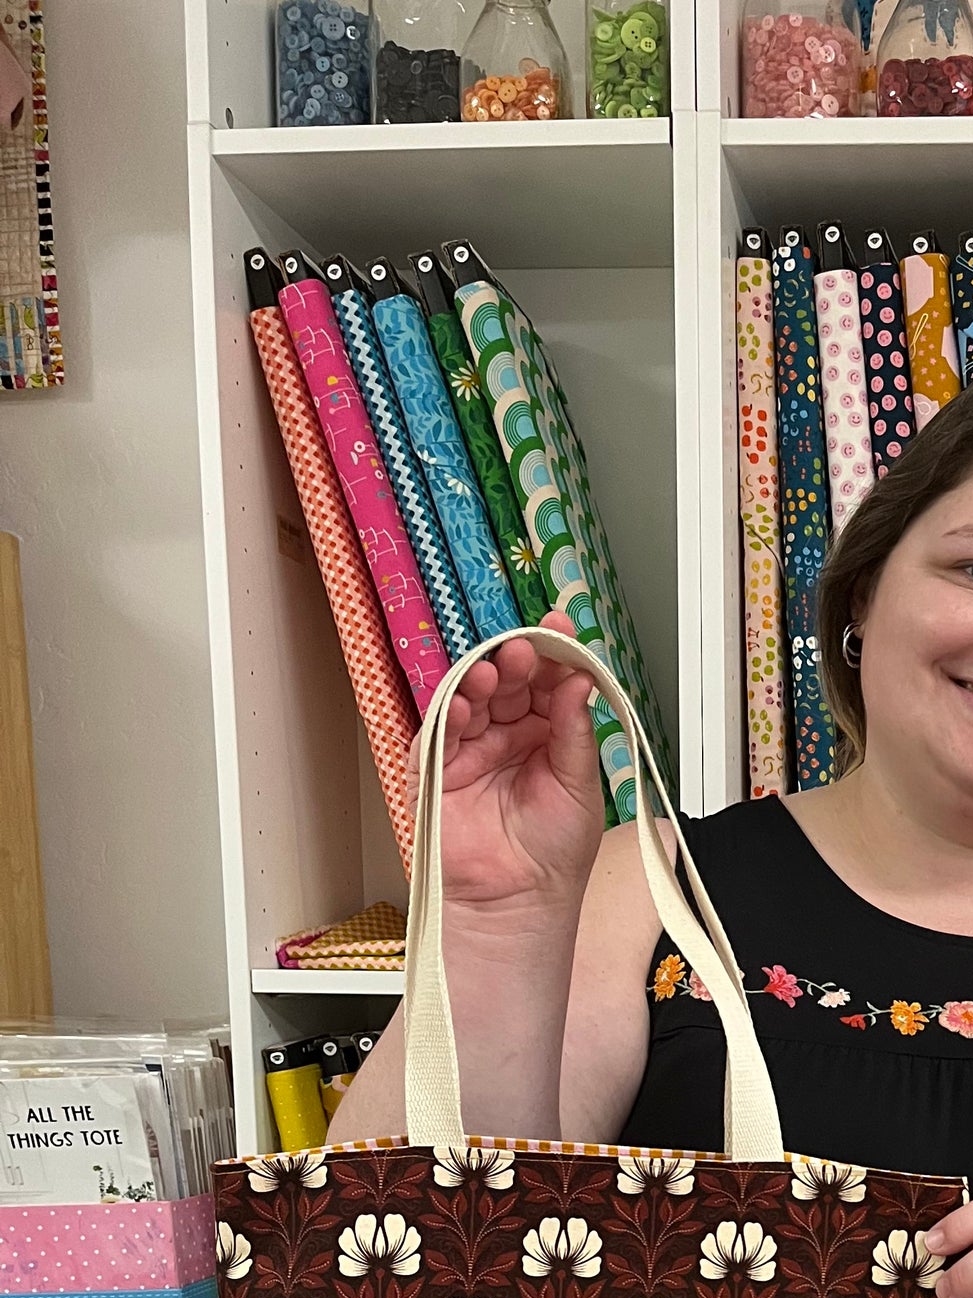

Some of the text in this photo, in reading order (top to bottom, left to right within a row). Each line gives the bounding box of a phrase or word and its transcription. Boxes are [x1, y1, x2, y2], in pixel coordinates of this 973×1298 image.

[27, 1105, 95, 1123] ALL THE
[7, 1129, 123, 1149] THINGS TOTE
